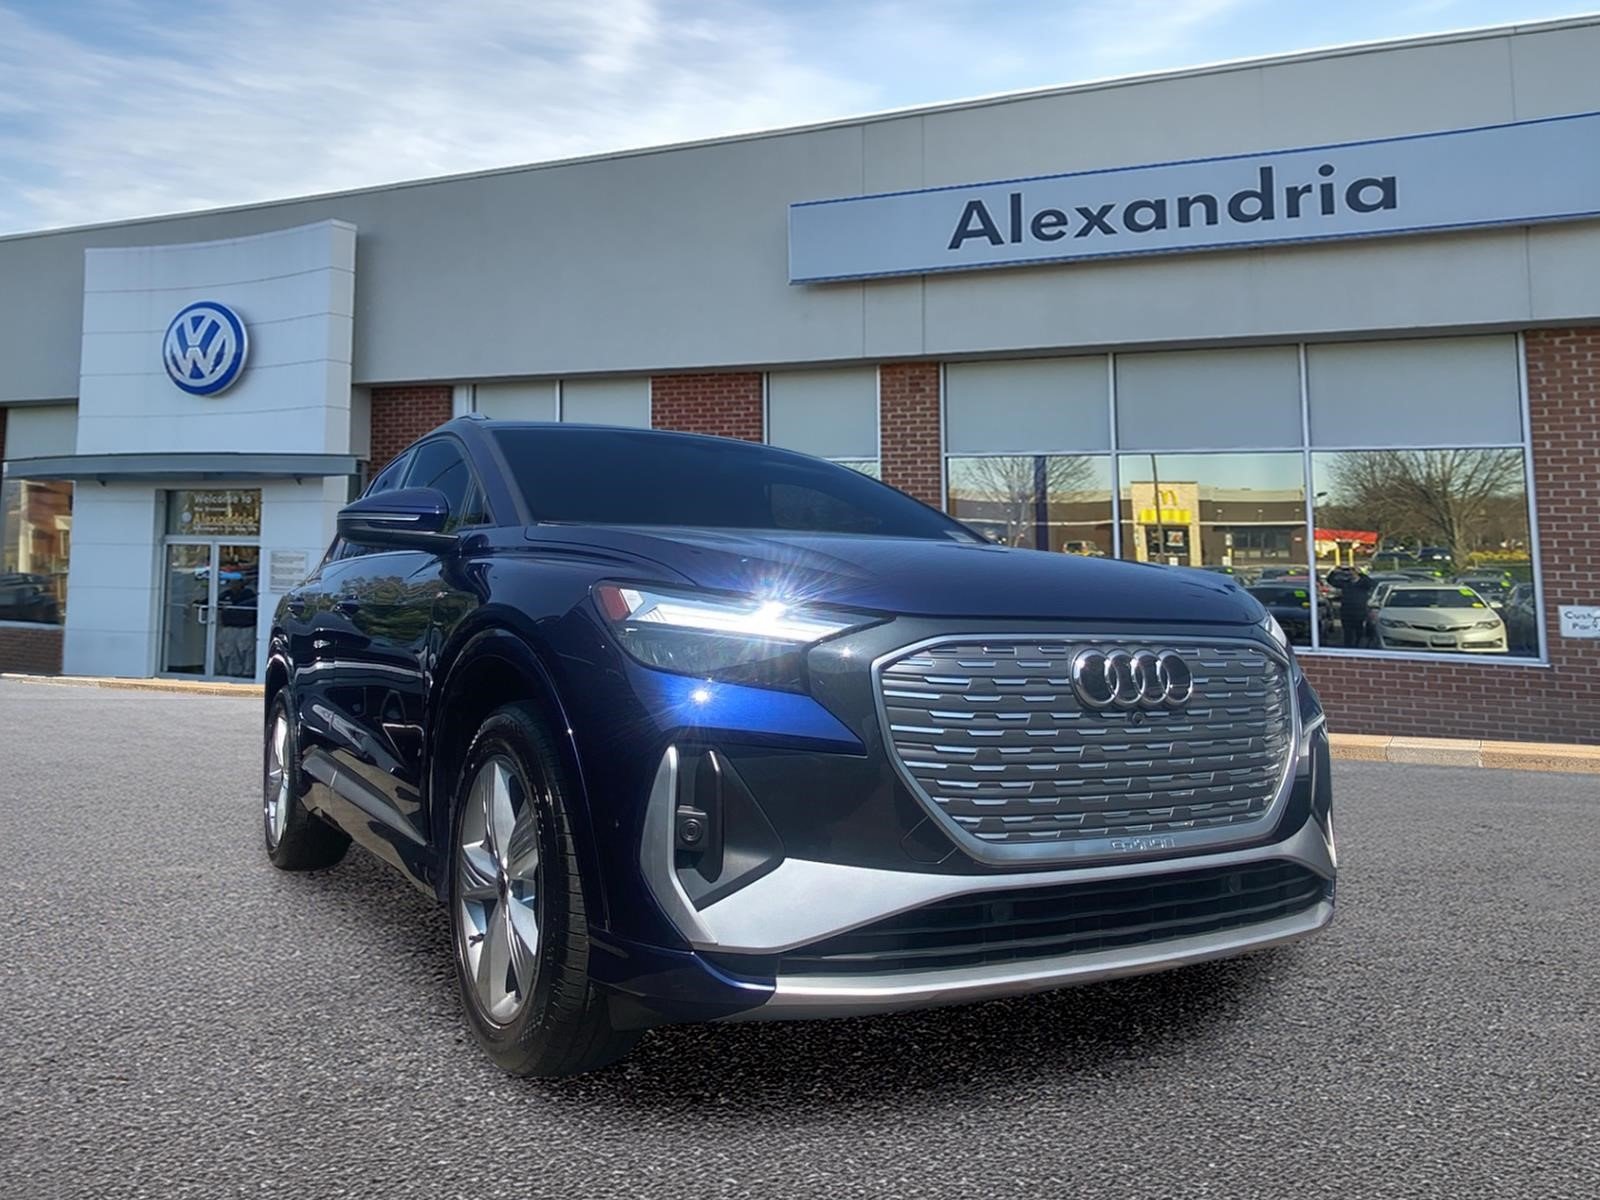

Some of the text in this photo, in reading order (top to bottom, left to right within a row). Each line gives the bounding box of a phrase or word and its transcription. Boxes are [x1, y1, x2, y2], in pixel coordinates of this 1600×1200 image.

[946, 163, 1399, 250] Alexandria
[193, 494, 252, 504] Welcome to
